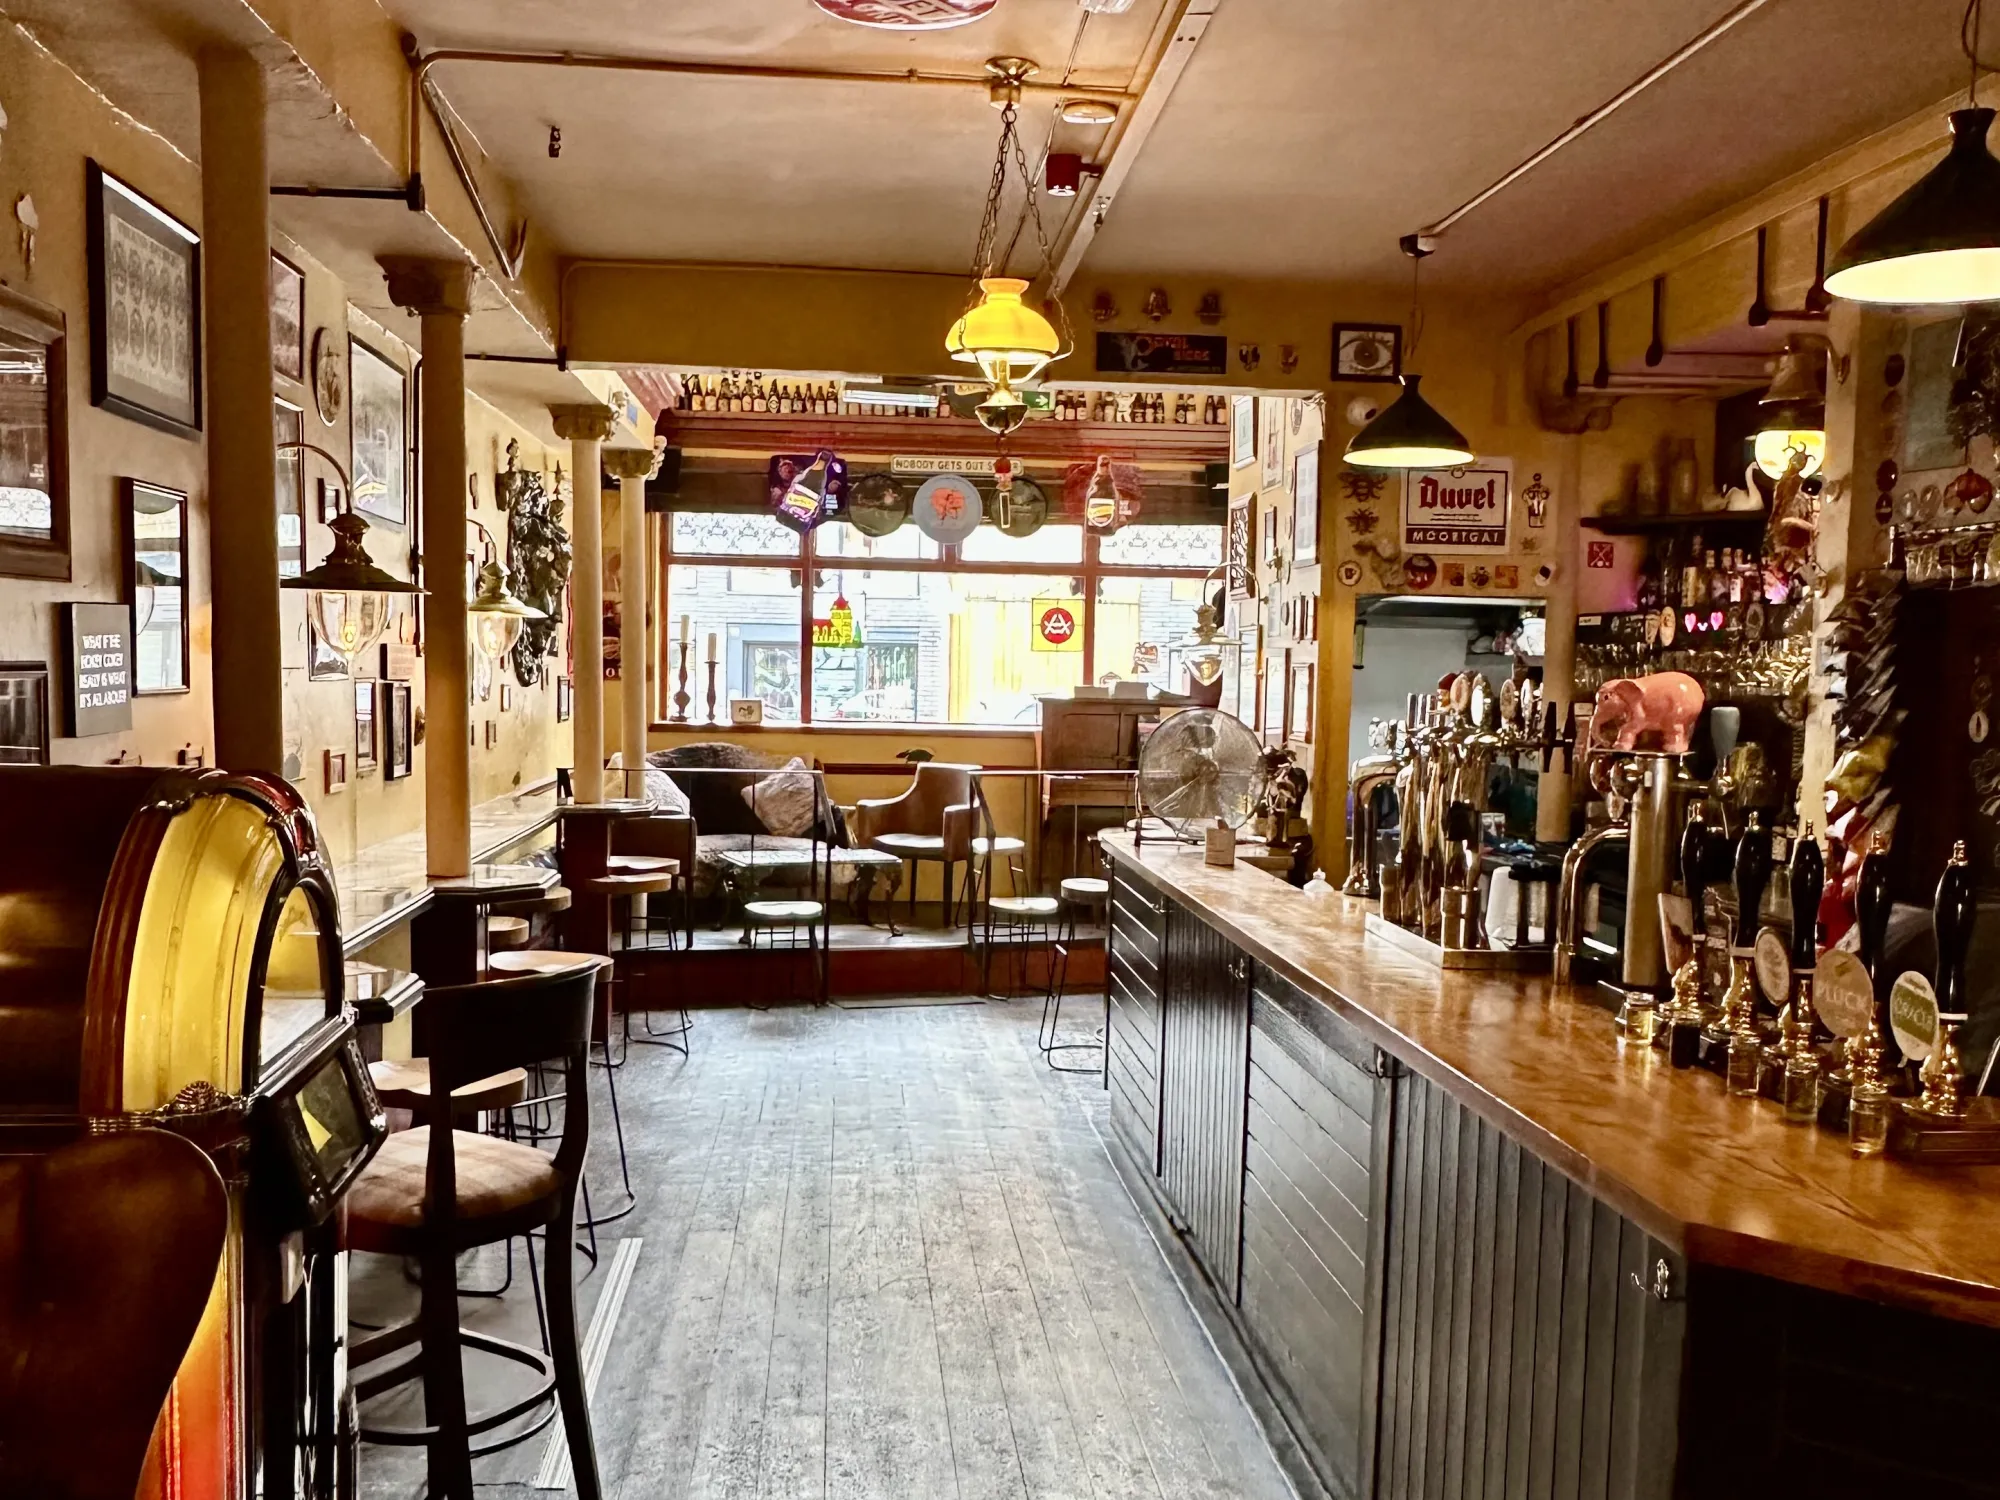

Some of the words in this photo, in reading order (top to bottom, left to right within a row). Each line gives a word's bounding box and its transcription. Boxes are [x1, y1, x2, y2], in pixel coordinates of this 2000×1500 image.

[895, 459, 935, 470] NOBODY
[938, 460, 962, 471] GETS
[965, 461, 984, 471] OUT
[1417, 475, 1496, 510] Duvel
